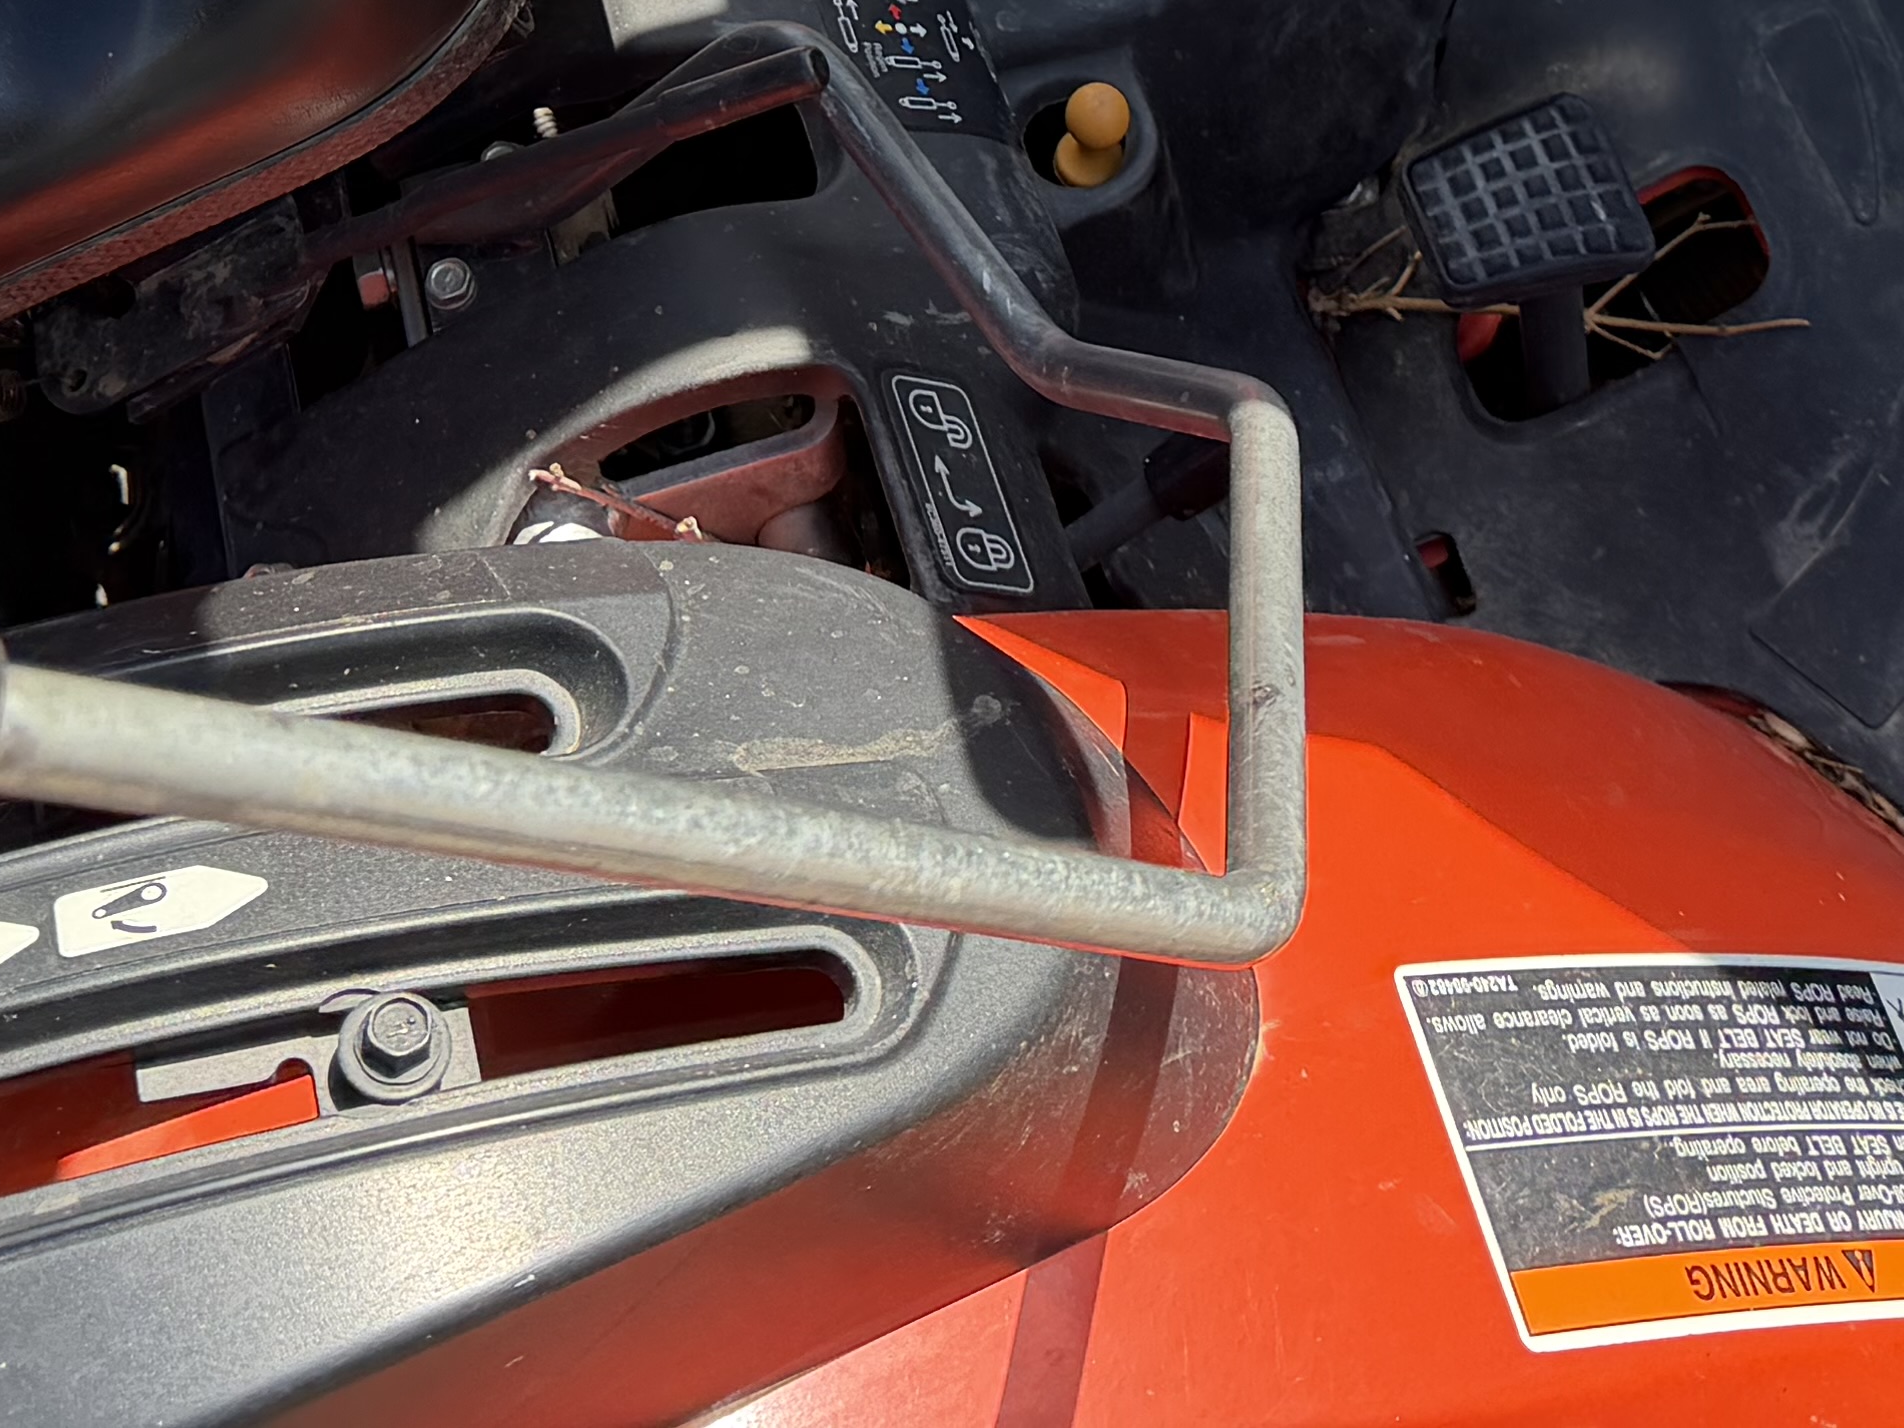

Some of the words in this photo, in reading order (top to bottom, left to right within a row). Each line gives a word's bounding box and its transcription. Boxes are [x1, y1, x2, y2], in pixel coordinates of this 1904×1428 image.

[1532, 978, 1608, 1002] warnings.
[1614, 980, 1644, 1001] and
[1650, 978, 1733, 999] instructions
[1739, 978, 1786, 1000] related
[1790, 981, 1834, 1003] ROPS
[1426, 1013, 1486, 1034] allows.
[1492, 1008, 1572, 1030] clearance
[1578, 1002, 1635, 1028] vertical
[1639, 1005, 1660, 1024] as
[1666, 1004, 1703, 1025] soon
[1707, 1004, 1728, 1023] as
[1731, 1003, 1779, 1026] ROPS
[1781, 1005, 1810, 1026] lock
[1813, 1006, 1839, 1024] and
[1562, 1031, 1619, 1054] folded.
[1622, 1030, 1639, 1052] is
[1643, 1029, 1695, 1052] ROPS
[1717, 1027, 1757, 1049] BELT
[1765, 1028, 1803, 1048] SEAT
[1809, 1028, 1841, 1045] wear
[1846, 1031, 1868, 1048] not
[1713, 1050, 1791, 1072] necessary.
[1795, 1048, 1861, 1071] absolutely
[1868, 1053, 1901, 1070] when
[1530, 1082, 1567, 1106] only
[1572, 1079, 1627, 1104] ROPS
[1631, 1081, 1658, 1101] the
[1663, 1078, 1695, 1099] fold
[1700, 1076, 1731, 1096] and
[1736, 1076, 1770, 1096] area
[1774, 1071, 1839, 1096] operating
[1845, 1076, 1868, 1095] the
[1585, 1108, 1615, 1131] THE
[1611, 1107, 1626, 1128] IN
[1627, 1107, 1641, 1127] IS
[1641, 1105, 1675, 1126] ROPS
[1675, 1104, 1704, 1124] THE
[1703, 1103, 1740, 1122] WHEN
[1739, 1101, 1809, 1124] PROTECTION
[1809, 1100, 1867, 1122] OPERATOR
[1867, 1101, 1883, 1121] NO
[1883, 1102, 1895, 1120] IS
[1463, 1116, 1531, 1142] POSITION:
[1530, 1111, 1585, 1135] FOLDED
[1752, 1136, 1799, 1158] before
[1805, 1135, 1845, 1156] BELT
[1852, 1134, 1890, 1155] SEAT
[1706, 1157, 1767, 1184] position
[1772, 1161, 1819, 1184] locked
[1824, 1160, 1851, 1181] and
[1855, 1155, 1904, 1181] upright
[1780, 1185, 1851, 1207] Protective
[1718, 1215, 1767, 1242] FROM
[1770, 1211, 1825, 1234] DEATH
[1829, 1210, 1852, 1232] OR
[1612, 1218, 1714, 1247] ROLL-OVER:
[1684, 1257, 1846, 1302] WARNING
